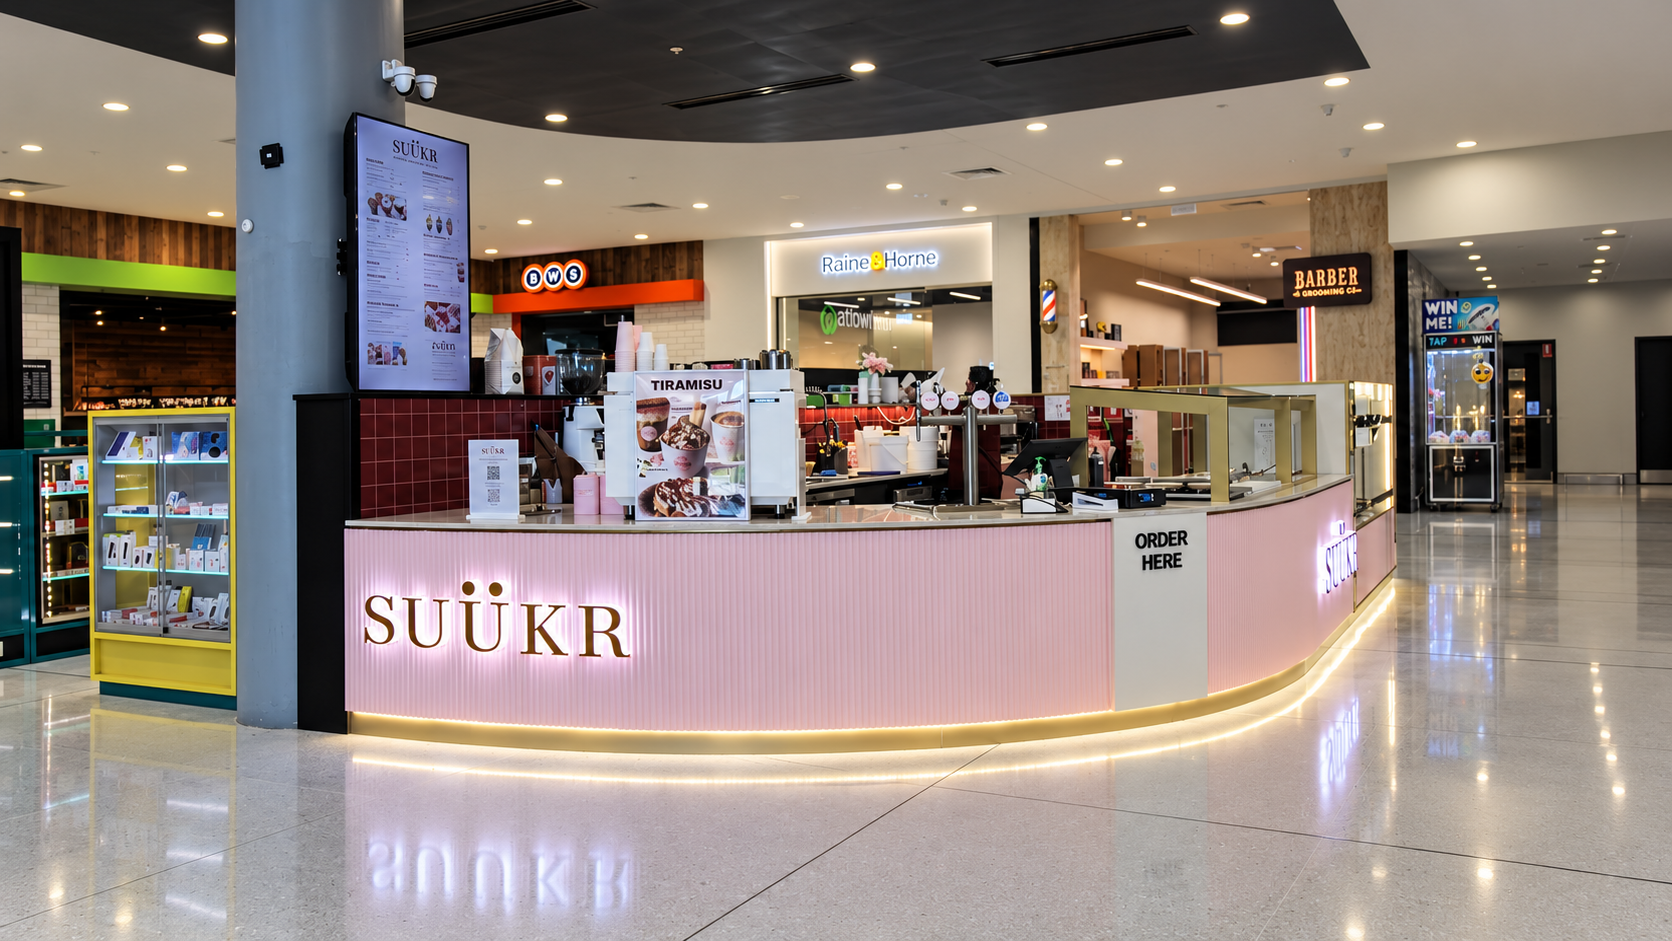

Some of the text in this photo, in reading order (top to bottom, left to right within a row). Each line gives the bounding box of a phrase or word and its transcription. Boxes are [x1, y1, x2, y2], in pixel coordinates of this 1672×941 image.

[392, 139, 438, 163] SUÜKR
[1294, 266, 1359, 290] BARBER
[1302, 287, 1345, 297] GROOMING
[1424, 299, 1458, 316] WIN
[1425, 316, 1453, 331] ME!
[1429, 337, 1447, 346] TAP
[1472, 335, 1493, 345] WIN
[651, 379, 723, 391] TIRAMISU
[1134, 529, 1188, 550] ORDER
[1142, 552, 1182, 571] HERE
[364, 581, 631, 658] SUÜKR
